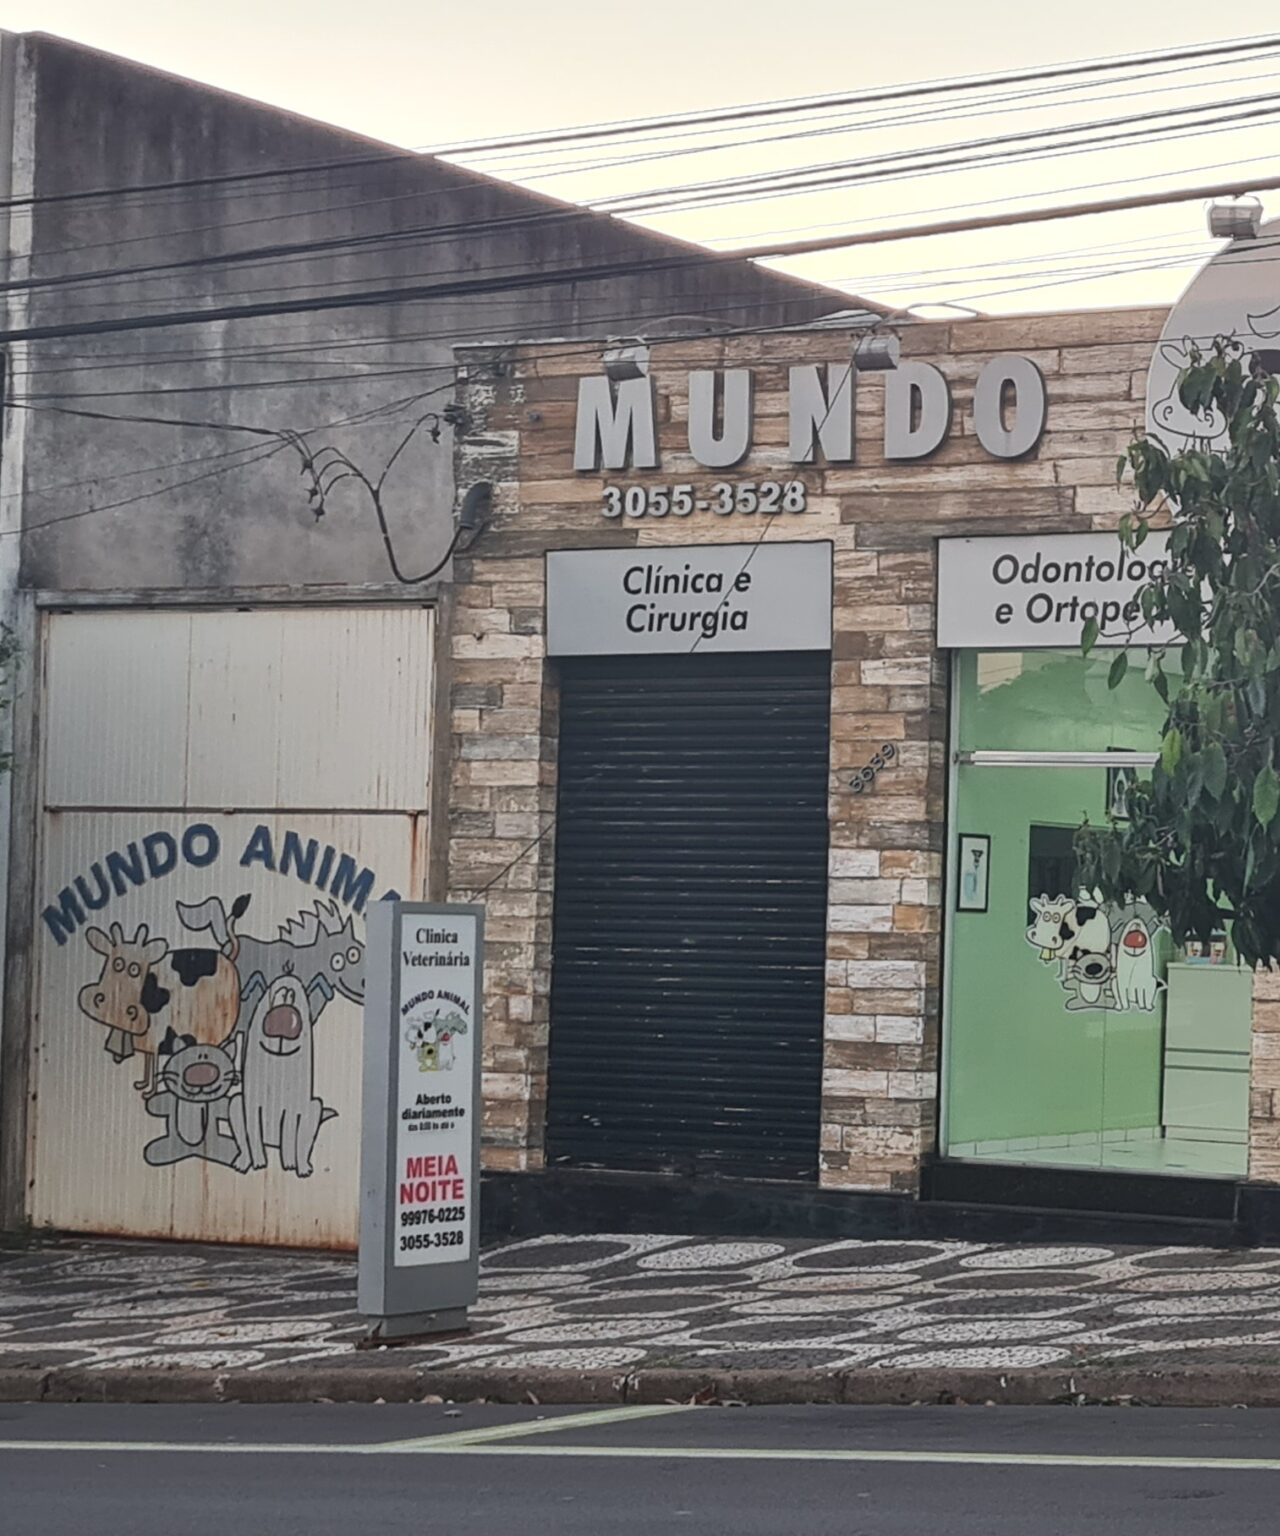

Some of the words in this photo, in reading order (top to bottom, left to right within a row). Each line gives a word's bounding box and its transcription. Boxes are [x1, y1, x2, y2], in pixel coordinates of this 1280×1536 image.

[574, 354, 1048, 471] MUNDO
[601, 481, 808, 519] 3055-3528
[623, 562, 724, 596] Clínica
[733, 570, 752, 593] e
[626, 602, 749, 640] Cirurgia
[995, 602, 1014, 624] e
[41, 823, 221, 946] MUNDO
[239, 825, 401, 916] ANIM
[402, 951, 471, 968] Veterinária
[401, 990, 435, 1016] MUNDO
[437, 989, 470, 1015] ANIMAL
[416, 1093, 452, 1106] Aberto
[402, 1106, 465, 1120] diariamente
[406, 1154, 459, 1180] MEIA
[399, 1178, 465, 1205] NOITE
[401, 1205, 466, 1227] 99976-0225
[400, 1230, 464, 1251] 3055-3528
